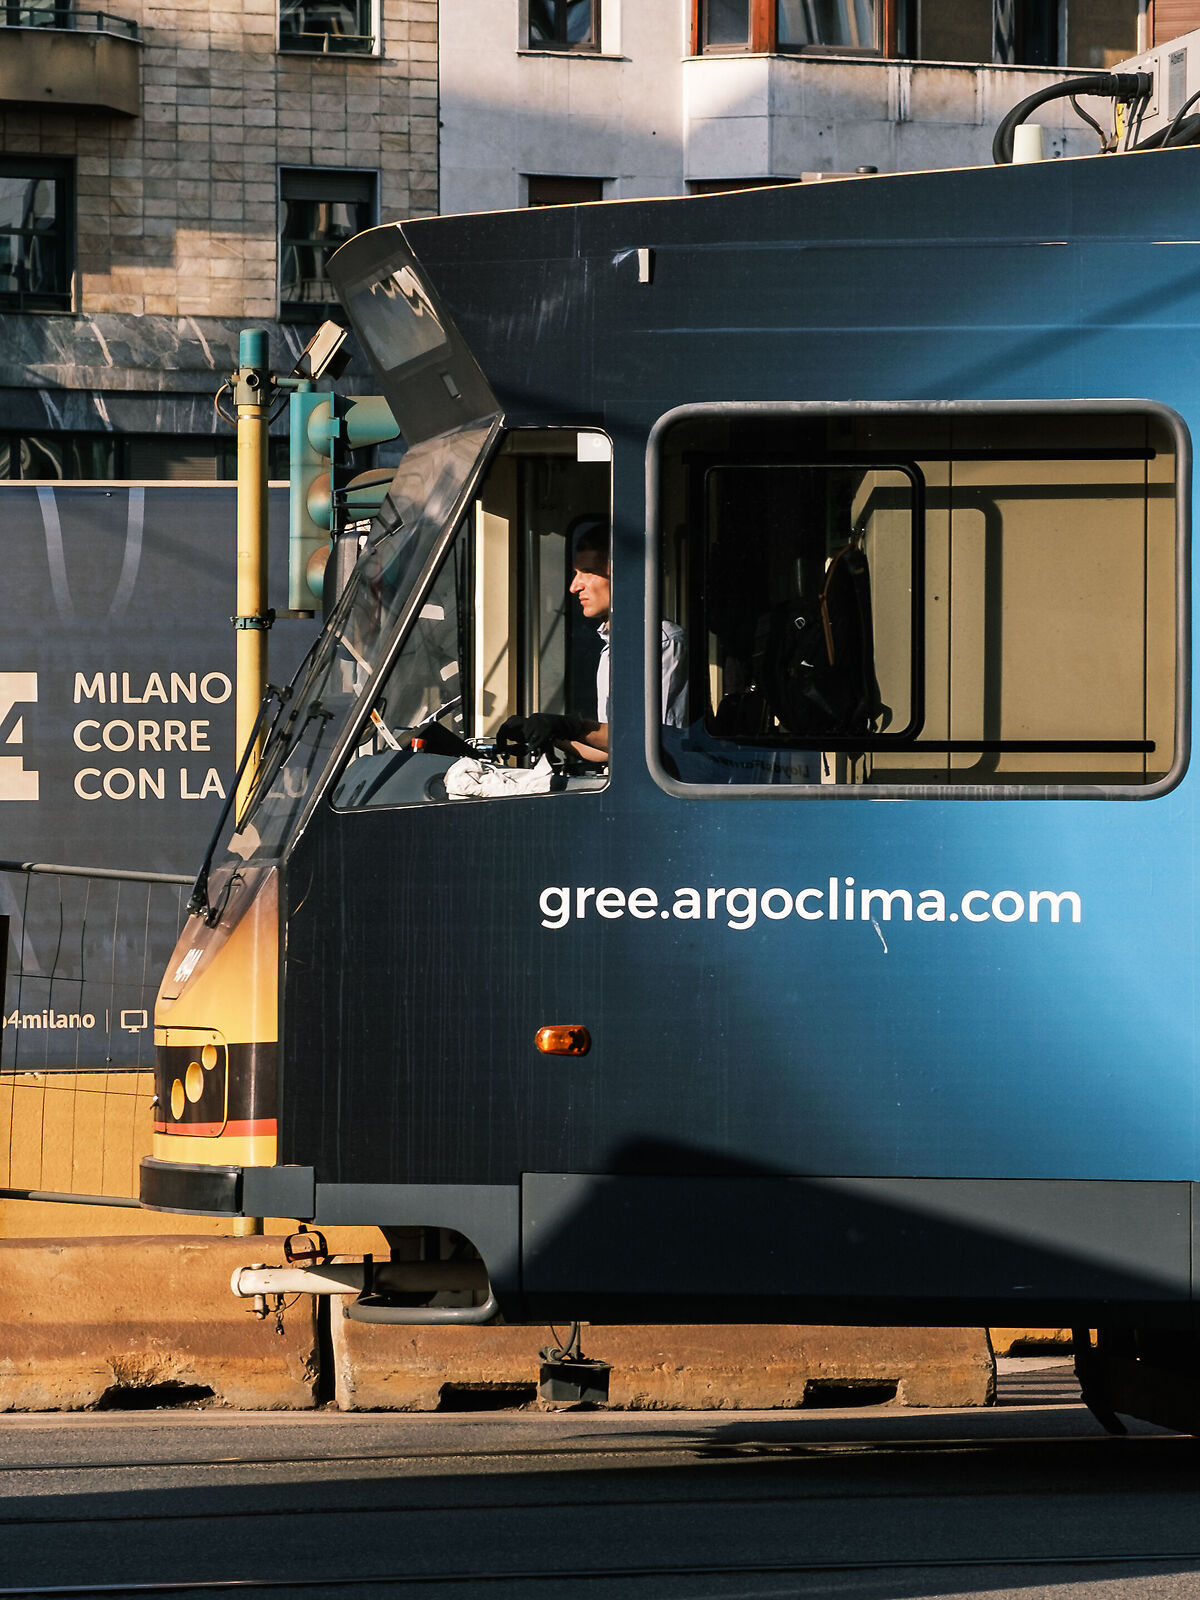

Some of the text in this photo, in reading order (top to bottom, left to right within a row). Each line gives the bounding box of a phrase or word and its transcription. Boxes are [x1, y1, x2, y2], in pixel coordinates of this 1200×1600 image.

[73, 671, 233, 705] MILANO
[73, 719, 211, 752] CORRE
[73, 767, 165, 800] CON
[180, 767, 226, 800] LA
[538, 876, 1083, 931] gree.argoclima.com
